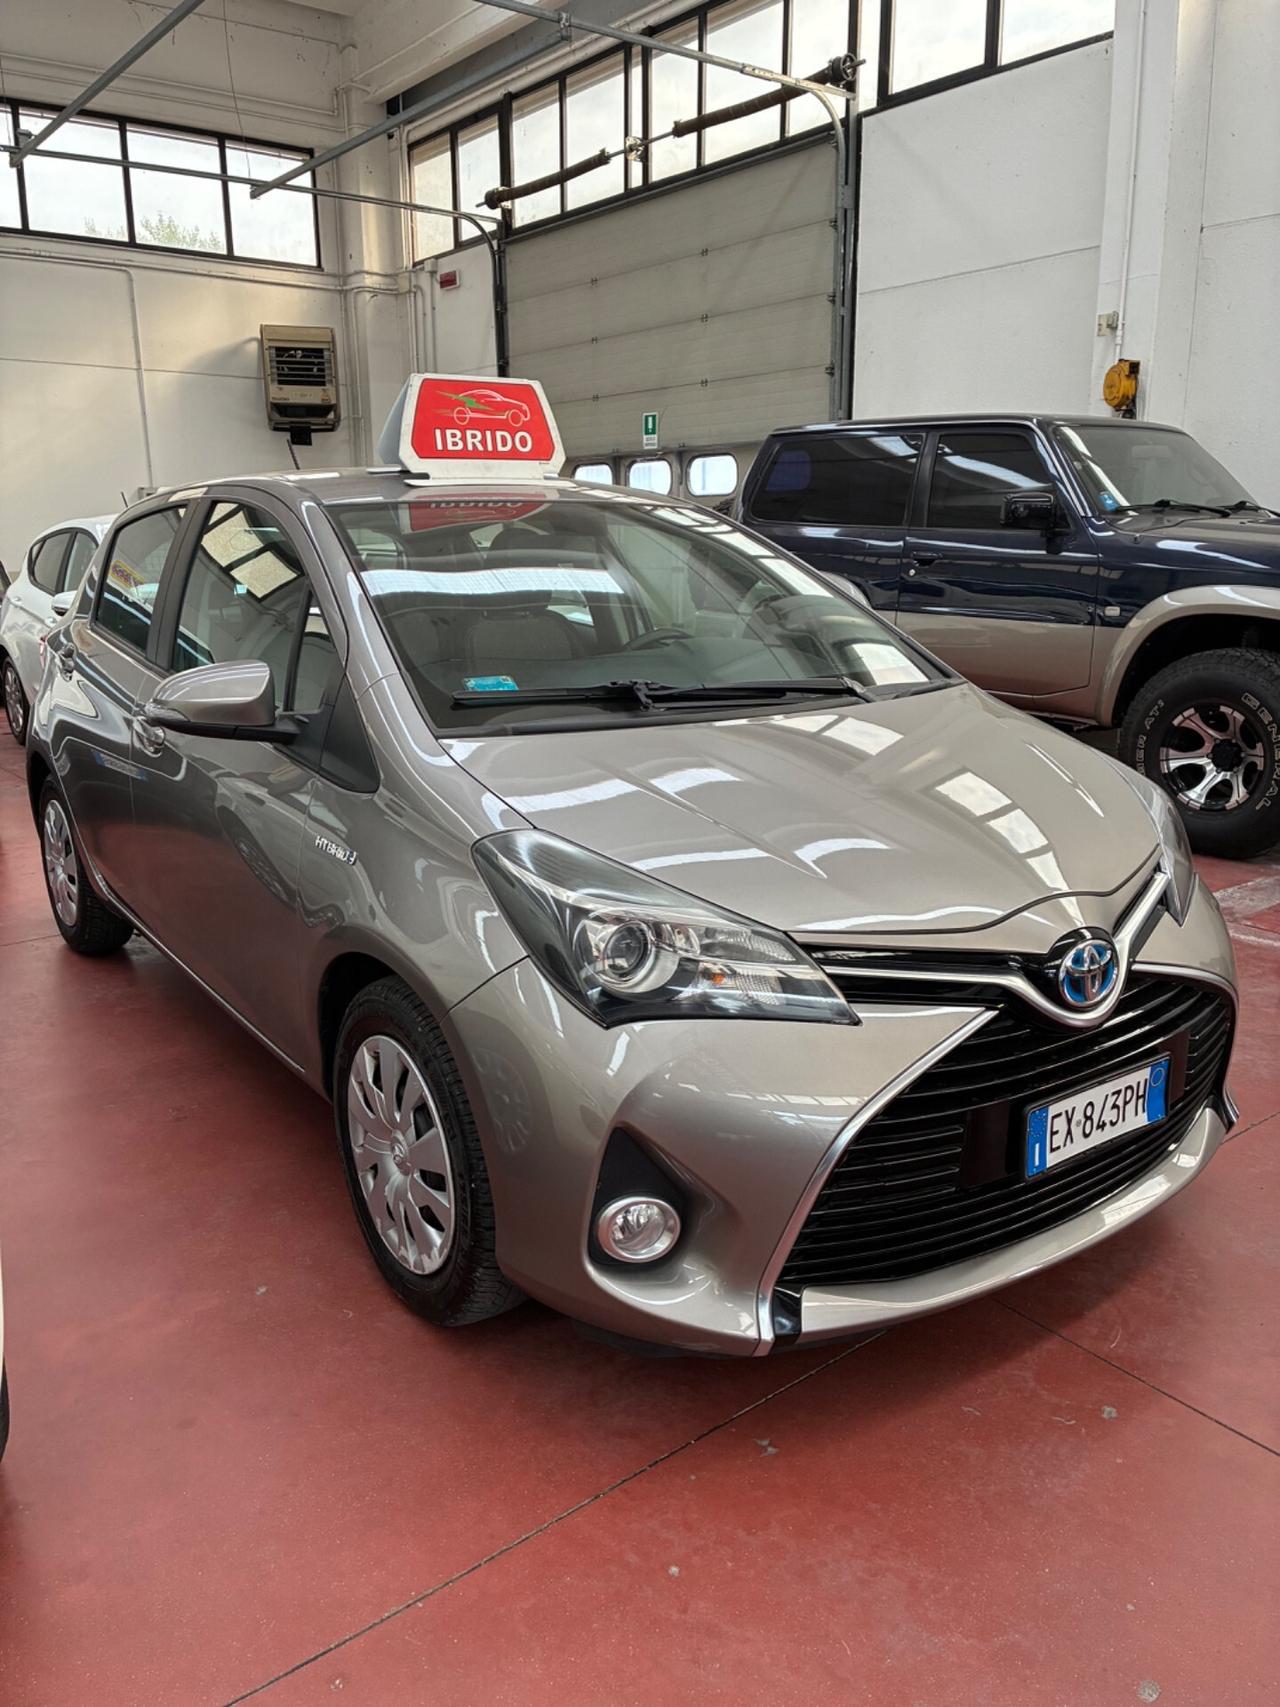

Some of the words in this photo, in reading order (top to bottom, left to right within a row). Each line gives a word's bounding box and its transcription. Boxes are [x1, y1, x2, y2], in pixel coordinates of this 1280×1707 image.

[434, 428, 533, 452] IBRIDO
[1050, 1106, 1076, 1154] EX
[1082, 1078, 1148, 1139] 843PH
